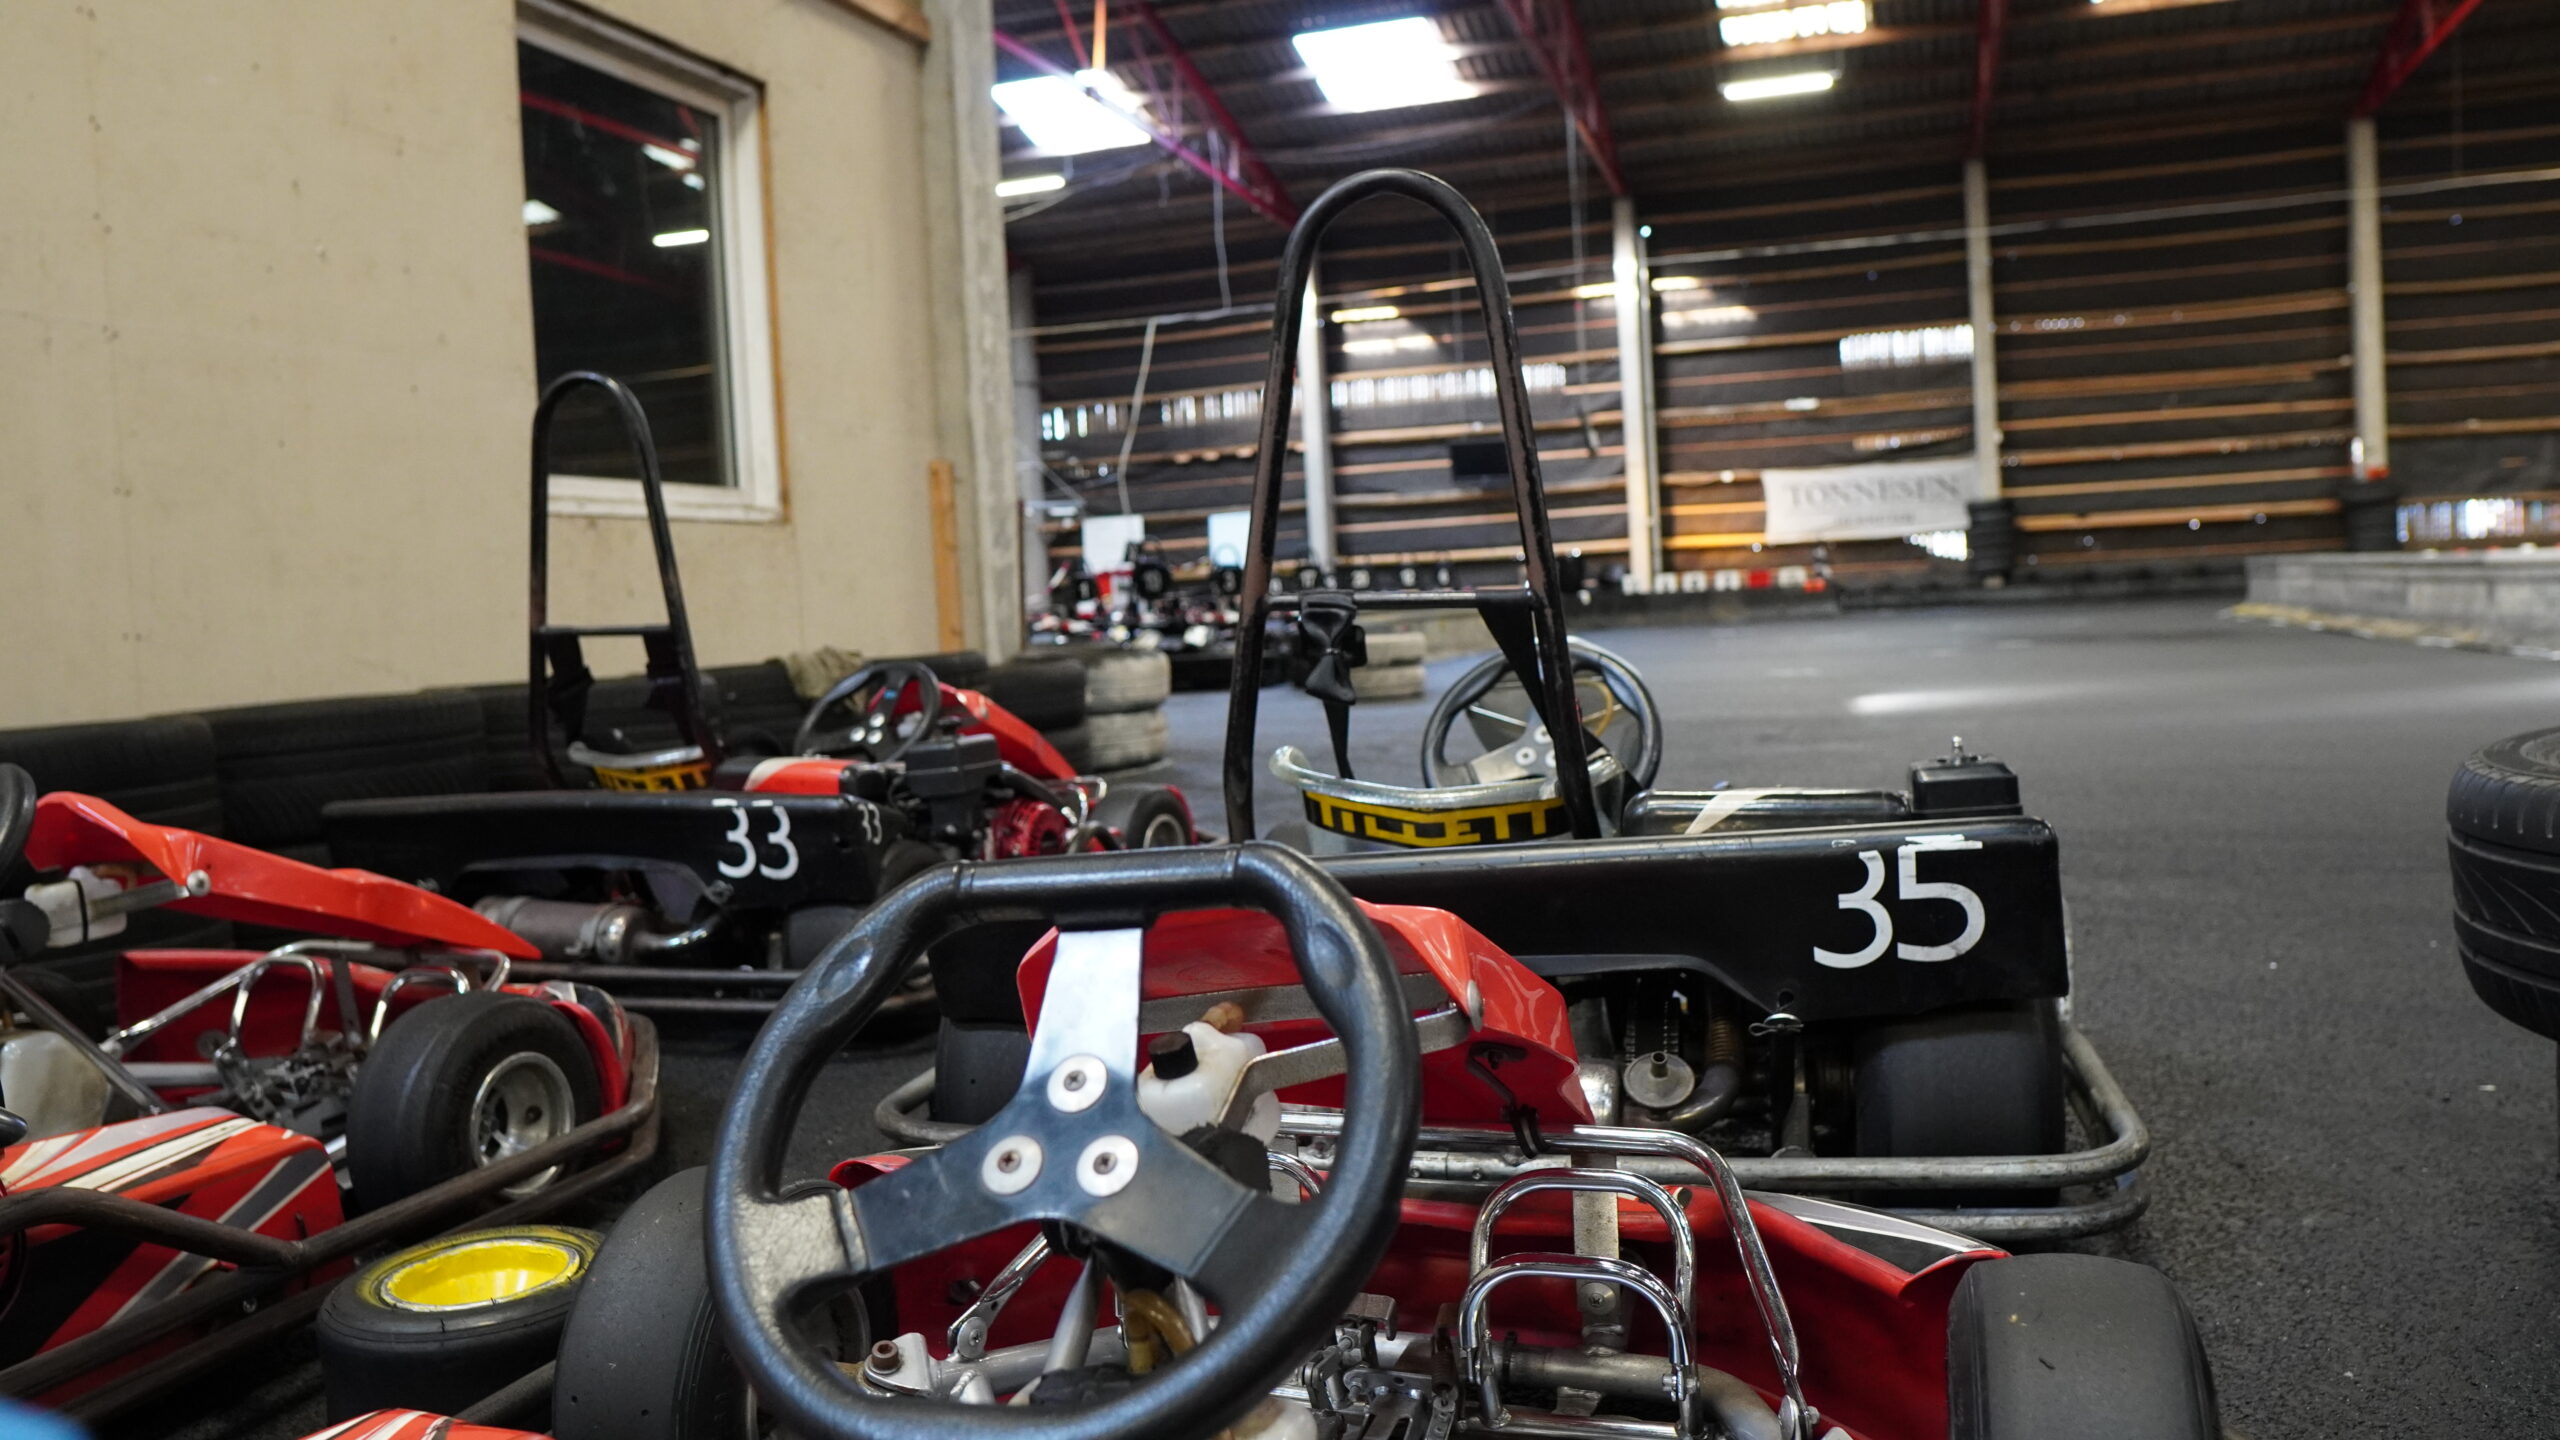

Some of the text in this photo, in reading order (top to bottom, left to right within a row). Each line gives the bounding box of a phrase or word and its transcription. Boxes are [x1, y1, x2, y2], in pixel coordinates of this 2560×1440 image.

[711, 798, 799, 880] 33
[857, 803, 883, 845] 33
[1305, 791, 1565, 848] TILLETT
[1813, 834, 1986, 969] 35
